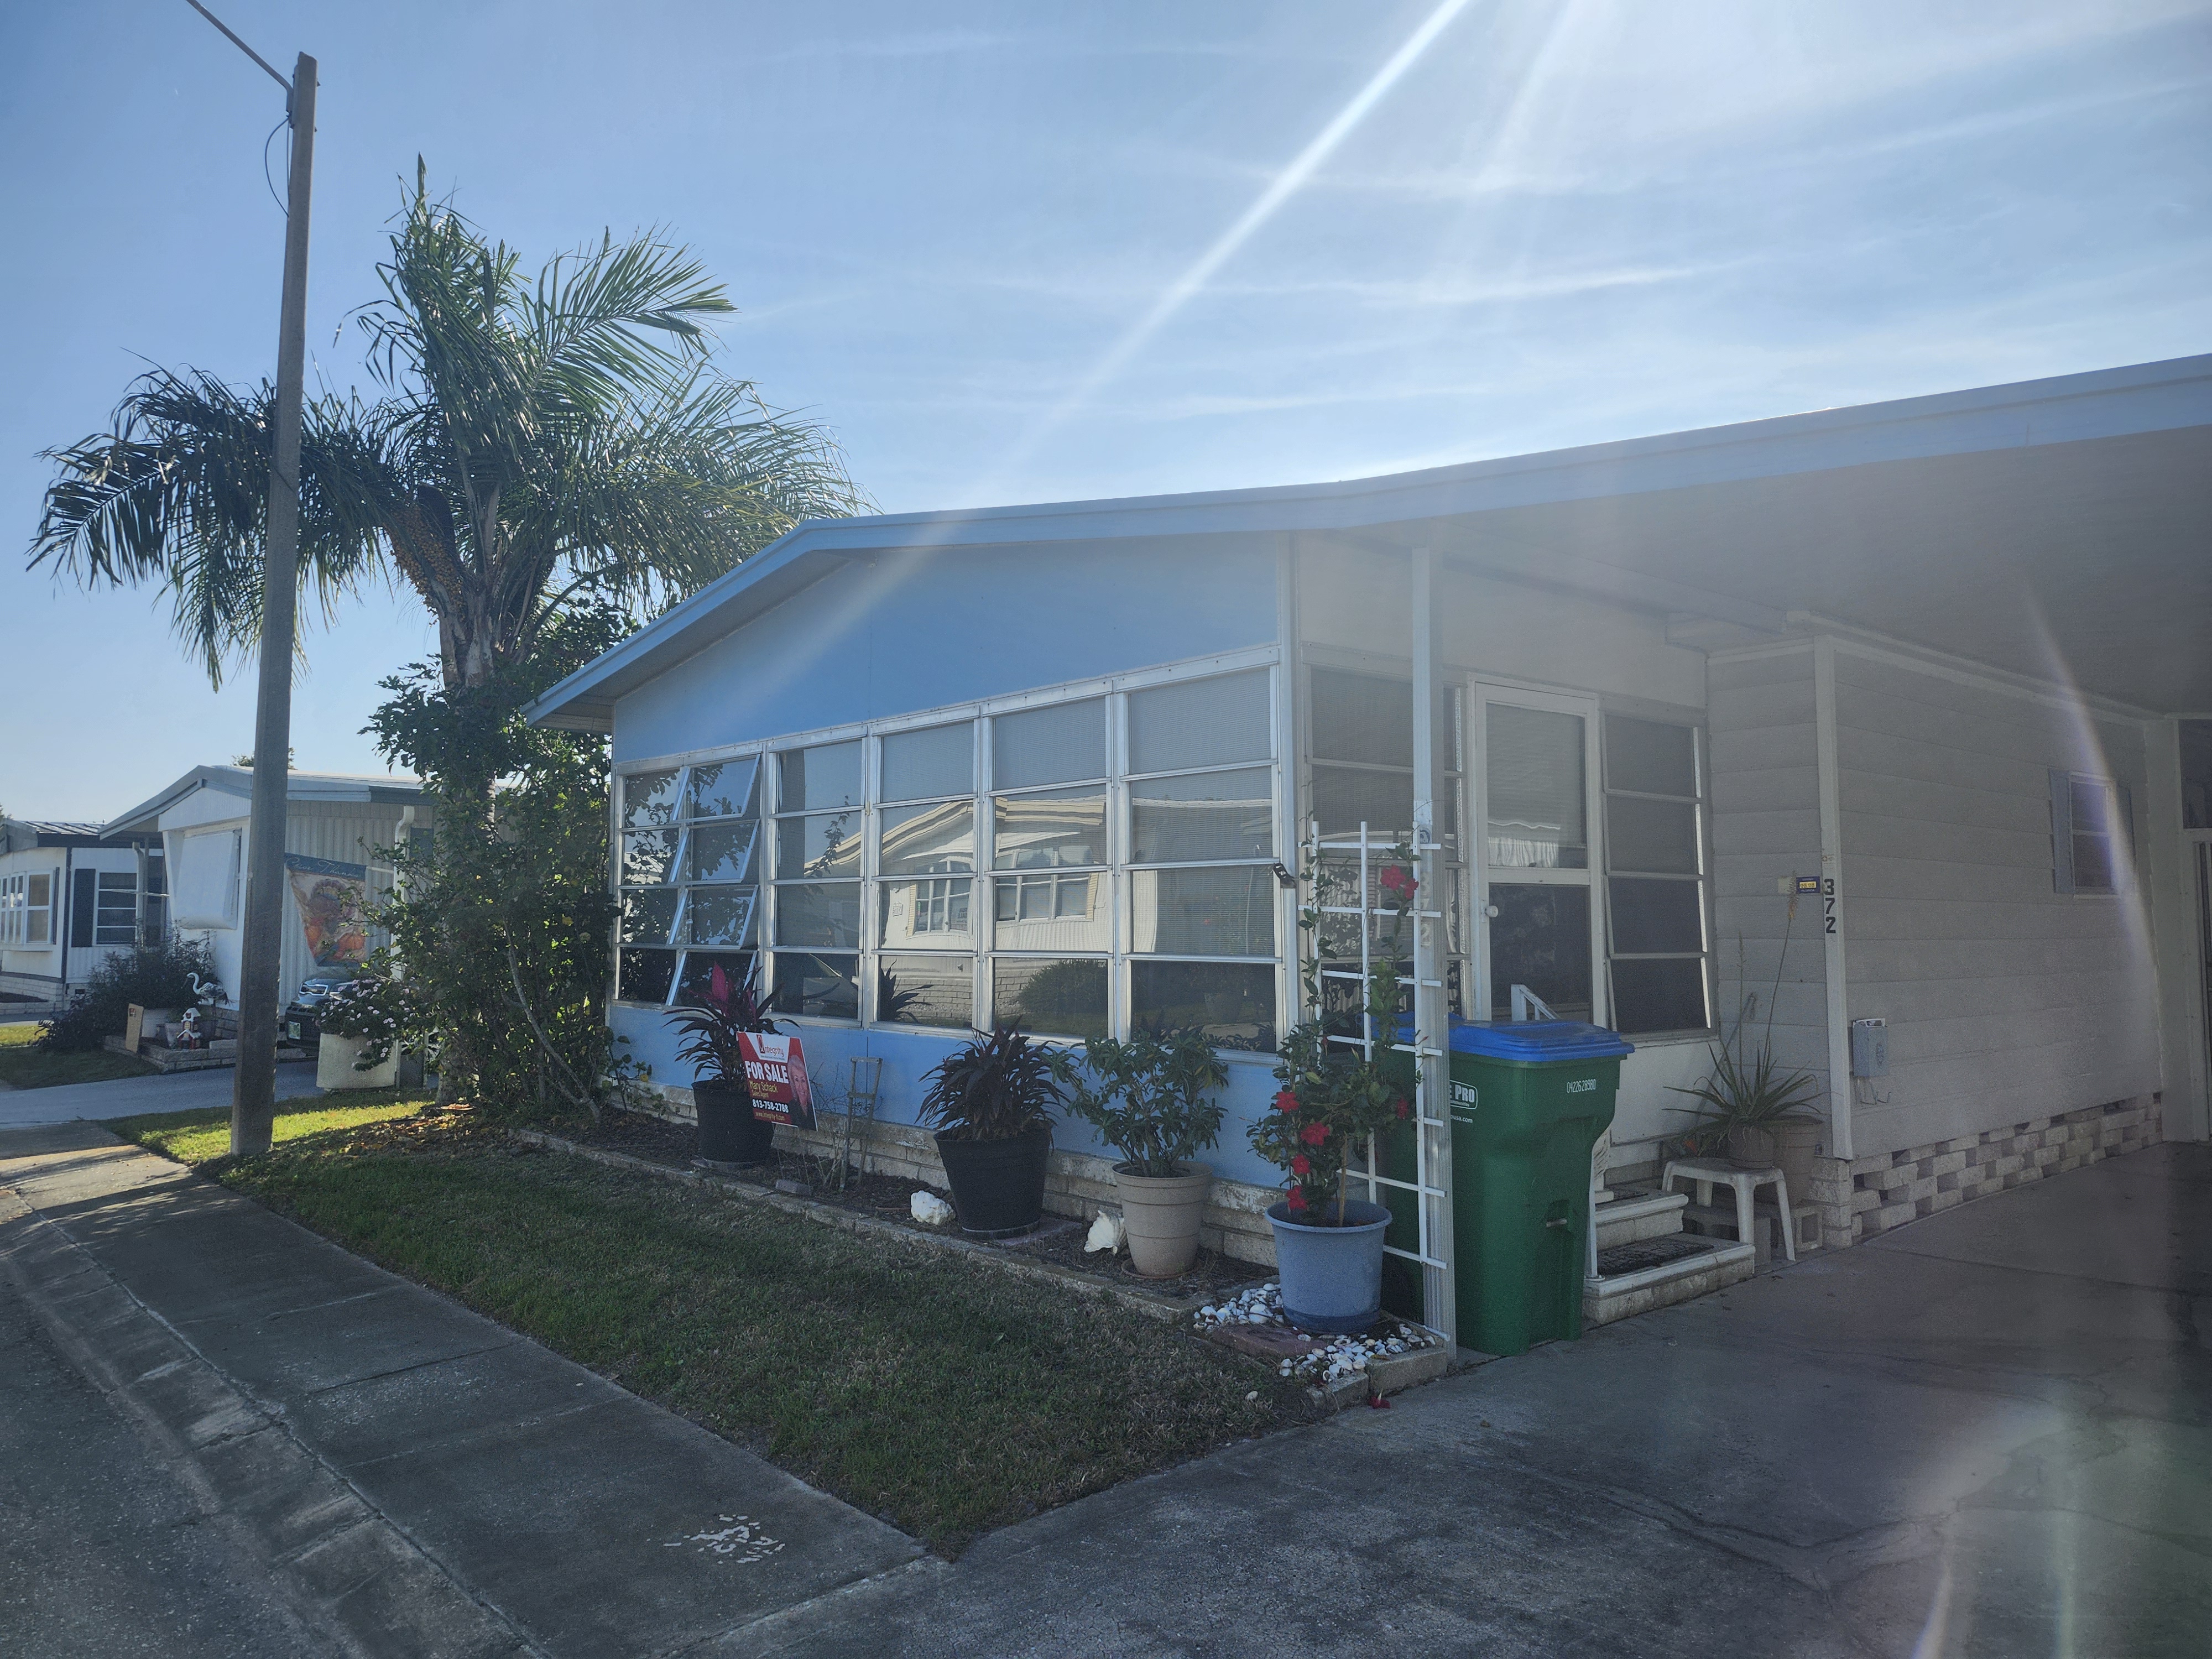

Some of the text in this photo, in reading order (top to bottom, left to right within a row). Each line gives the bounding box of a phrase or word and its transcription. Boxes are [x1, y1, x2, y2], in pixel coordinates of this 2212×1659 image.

[1824, 878, 1836, 933] 372
[744, 1061, 789, 1084] FOR SALE
[749, 1080, 778, 1093] Mary Schack
[1455, 1084, 1475, 1103] PRO
[752, 1099, 789, 1113] 813-758-2788
